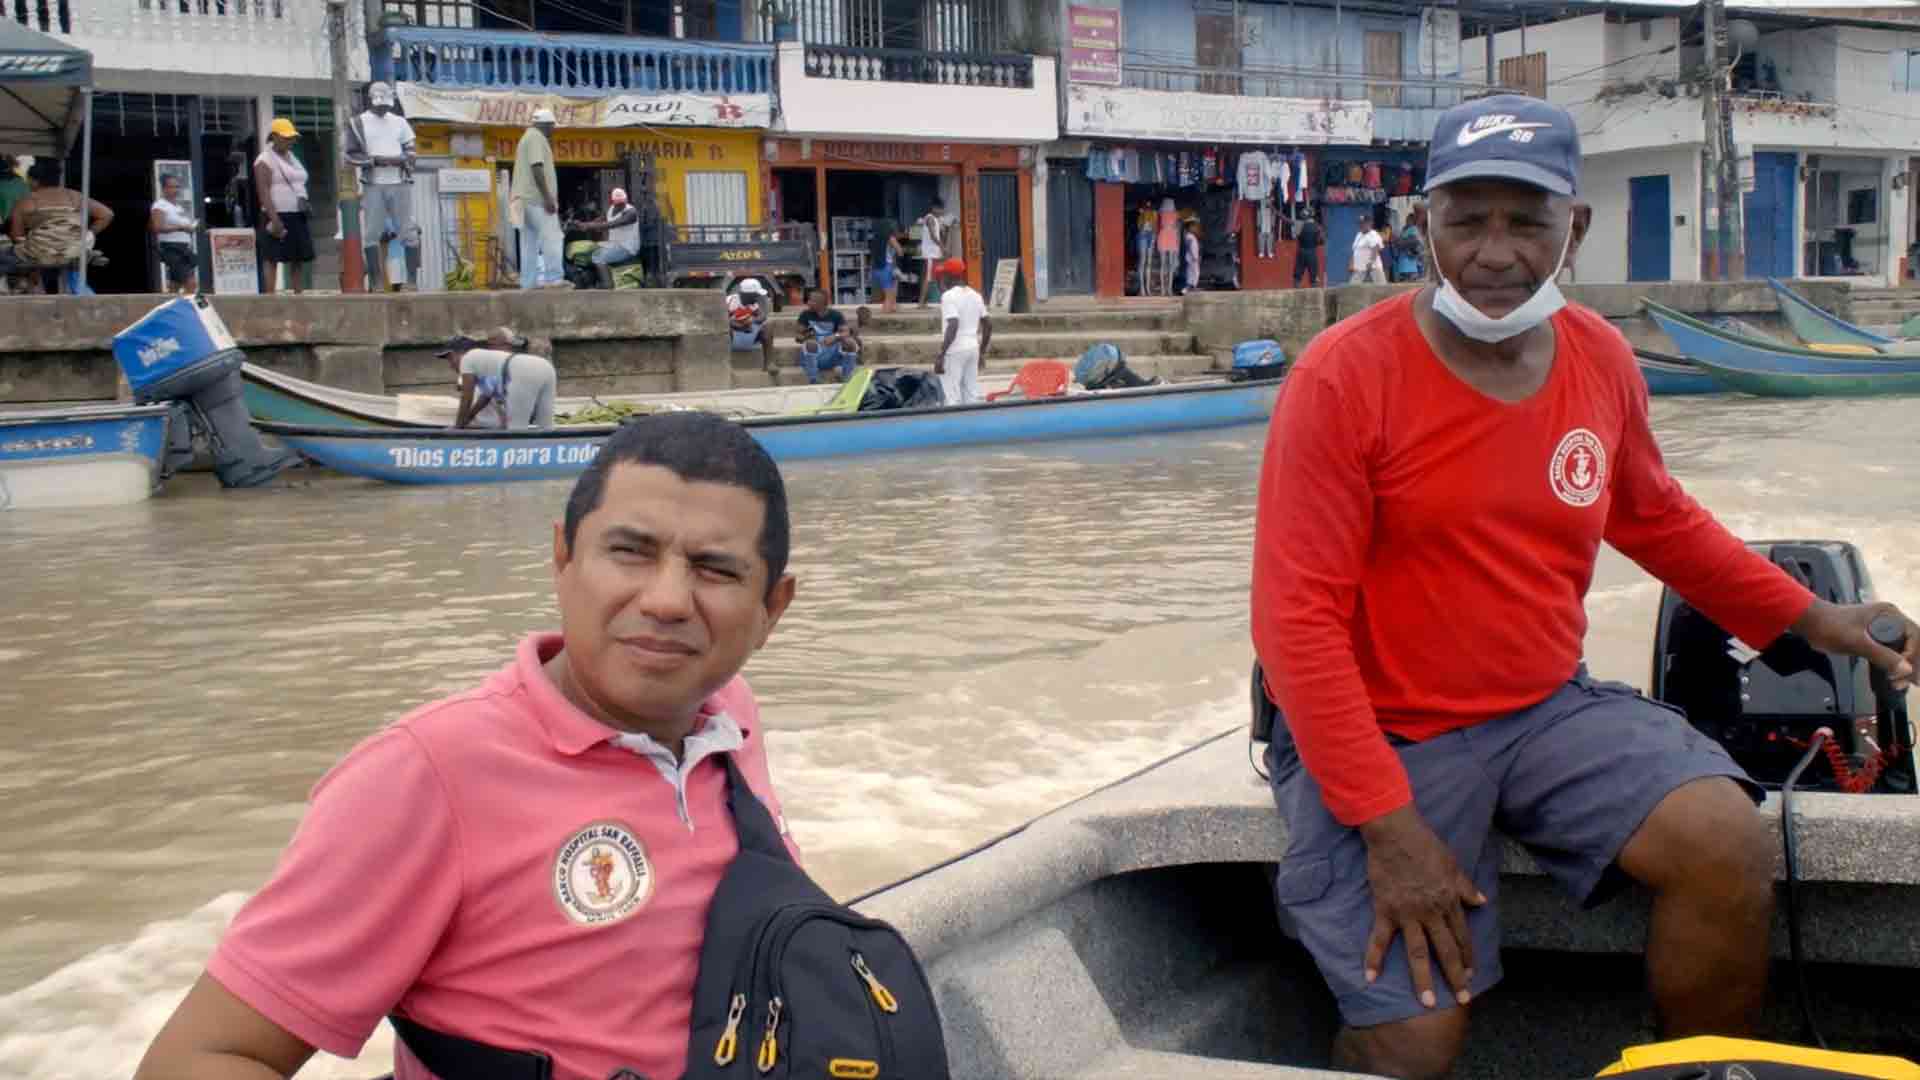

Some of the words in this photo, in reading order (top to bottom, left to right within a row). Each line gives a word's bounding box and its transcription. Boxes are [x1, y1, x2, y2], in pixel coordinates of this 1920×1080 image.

[611, 101, 682, 113] AQUI
[668, 114, 697, 123] ES
[1473, 114, 1517, 129] NIKE
[1508, 129, 1535, 143] SB
[388, 446, 445, 468] Dios
[450, 446, 497, 467] esta
[503, 446, 550, 468] para
[561, 829, 598, 865] HOSPITAL
[601, 826, 618, 840] SAN
